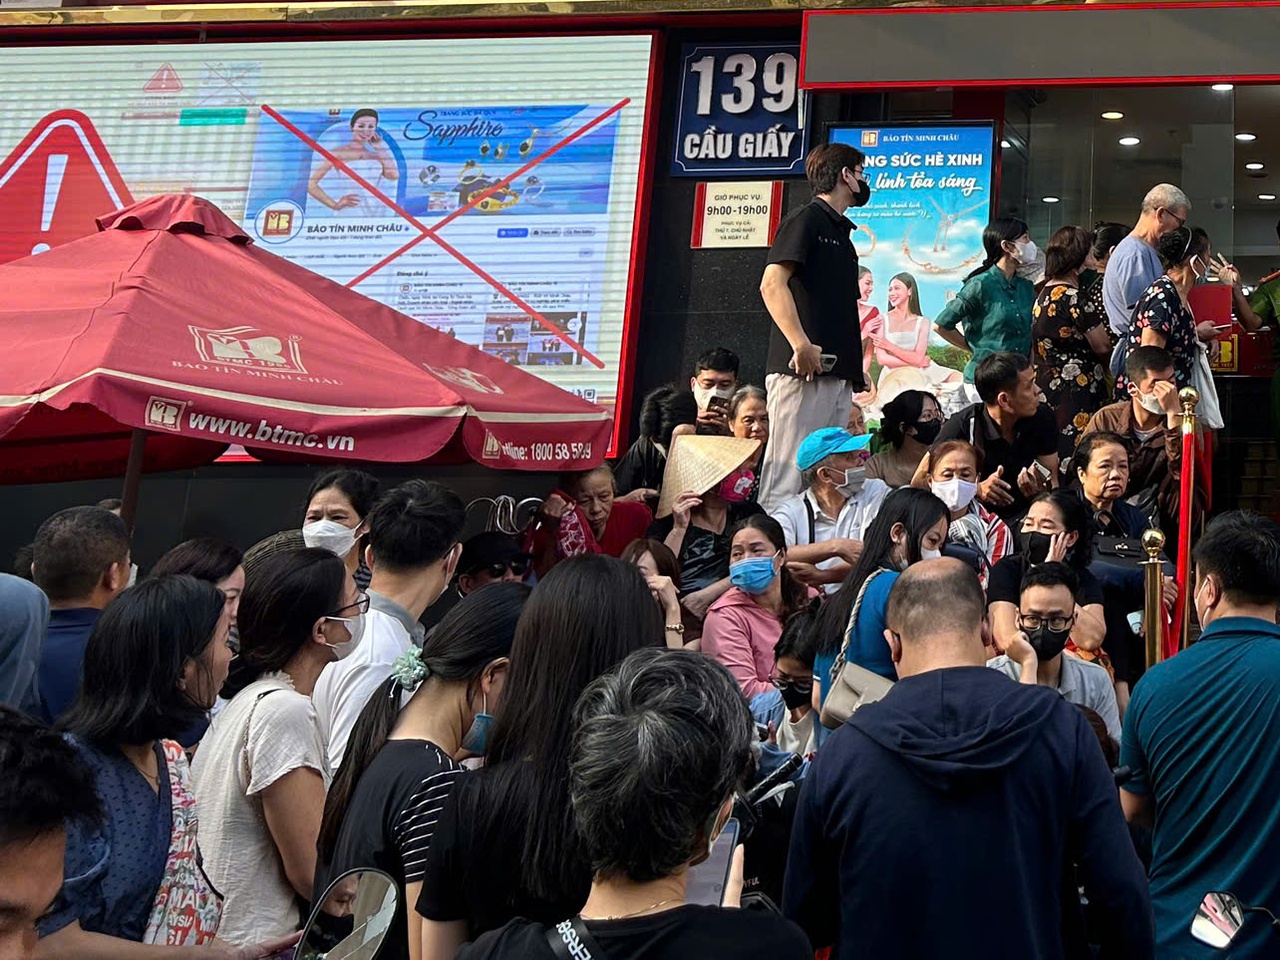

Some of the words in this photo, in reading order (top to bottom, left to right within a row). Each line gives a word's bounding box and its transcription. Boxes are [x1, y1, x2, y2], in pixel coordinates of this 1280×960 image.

[690, 52, 799, 115] 139
[402, 109, 504, 146] Sapphire
[683, 124, 733, 160] CẦU
[737, 123, 796, 158] GIẤY
[890, 151, 922, 167] SỨC
[925, 150, 944, 166] HÈ
[946, 153, 983, 166] XINH
[330, 223, 346, 232] TÍN
[348, 224, 374, 232] MINH
[376, 223, 402, 232] CHÂU
[188, 411, 355, 452] www.btmc.vn
[531, 442, 553, 460] 1800
[555, 443, 570, 460] 58
